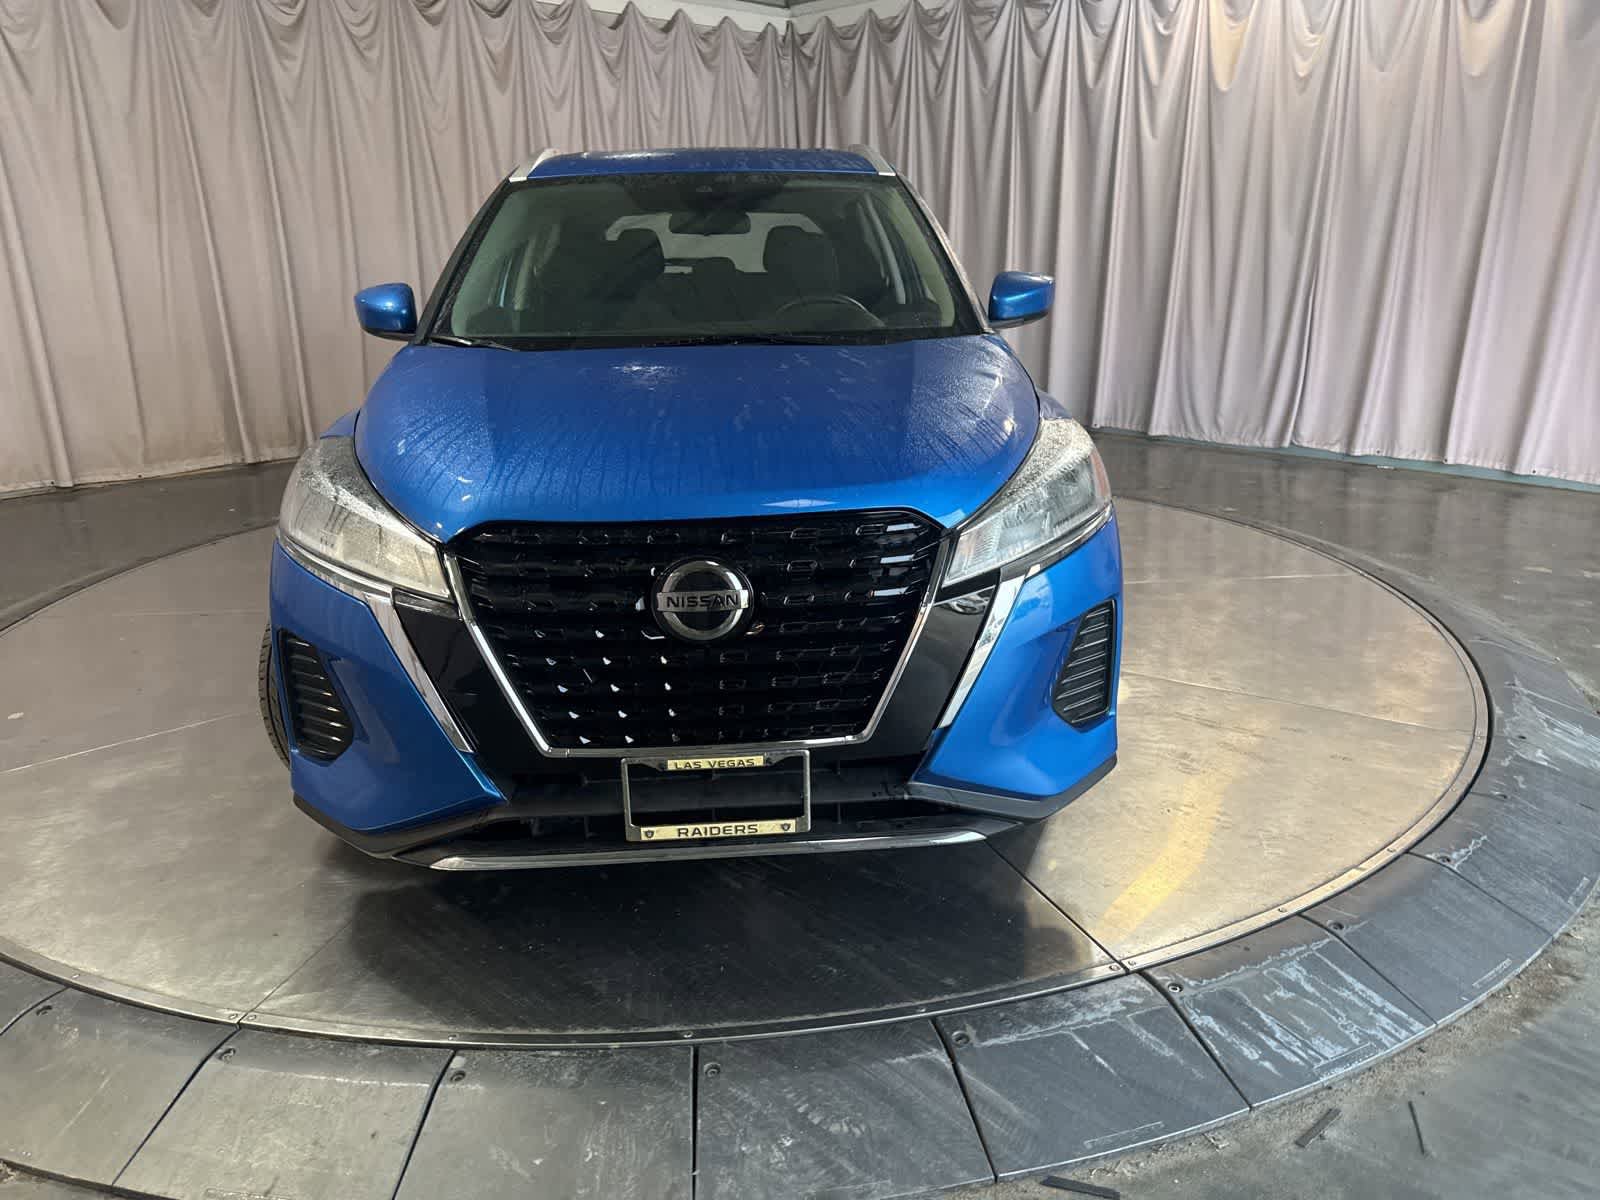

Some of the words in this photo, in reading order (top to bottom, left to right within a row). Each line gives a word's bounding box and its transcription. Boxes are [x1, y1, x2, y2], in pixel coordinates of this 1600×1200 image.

[666, 594, 739, 609] NISSAN
[674, 761, 702, 770] LAS
[708, 758, 755, 769] VEGAS
[677, 823, 759, 838] RAIDERS
